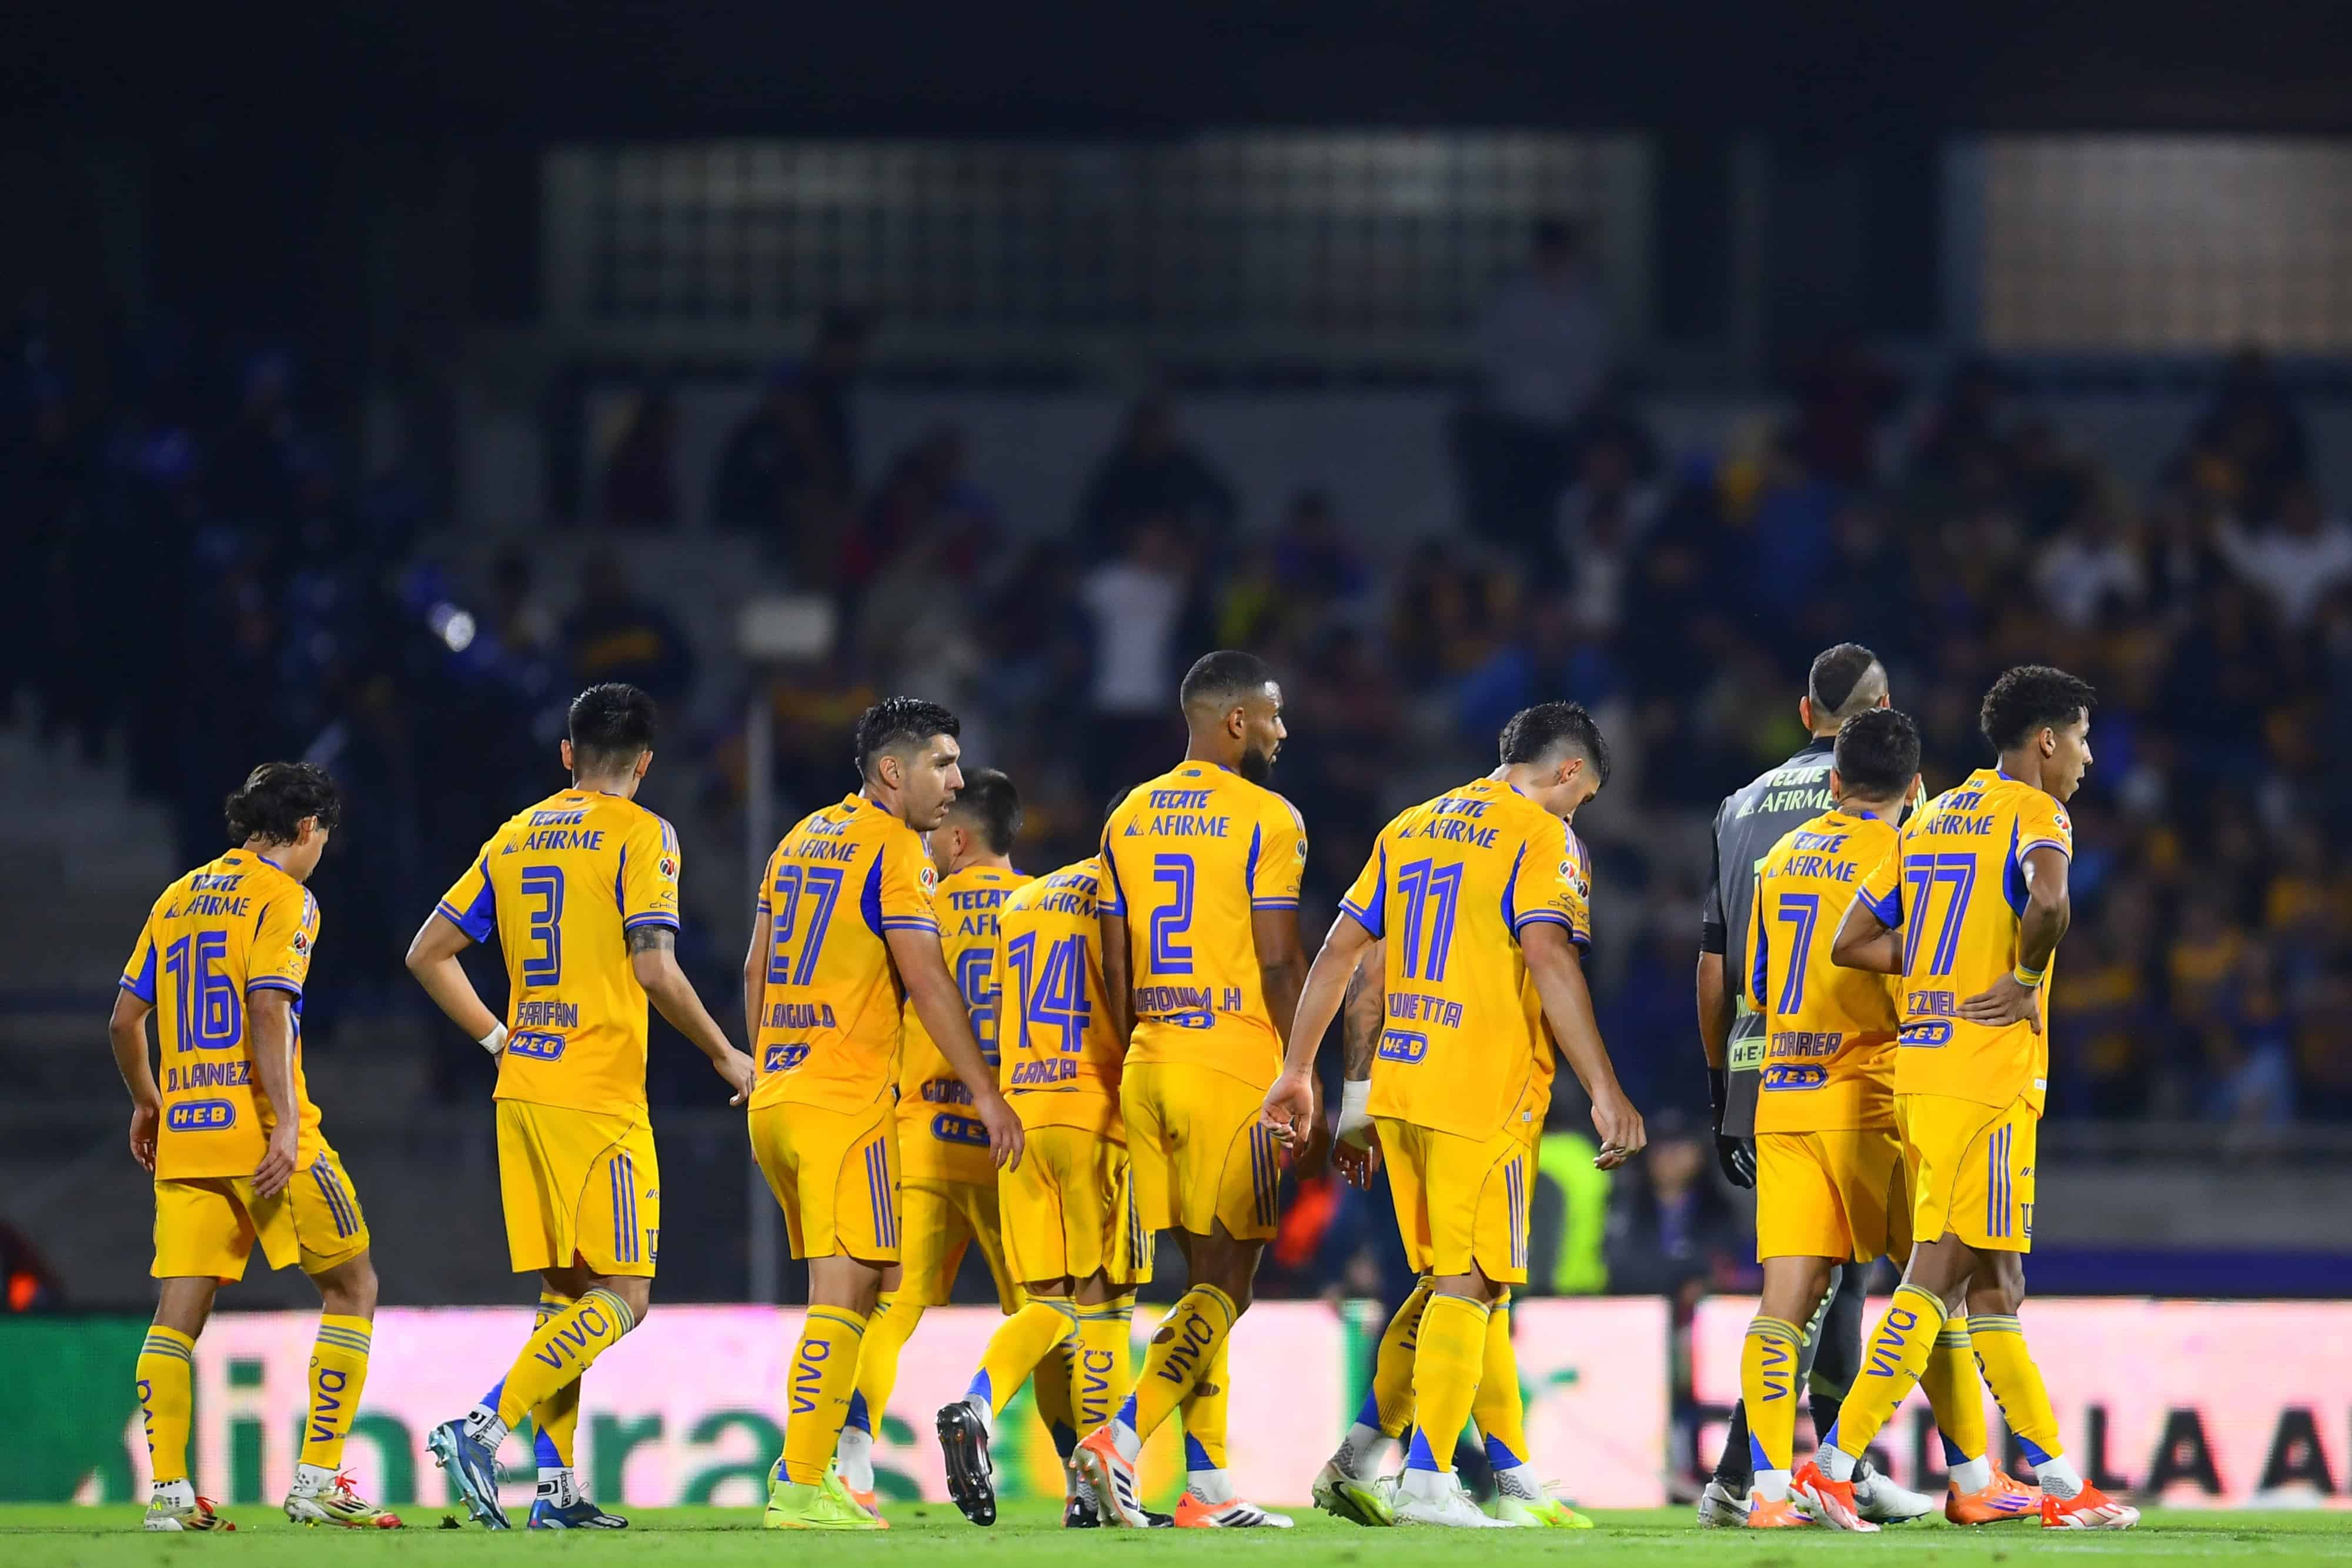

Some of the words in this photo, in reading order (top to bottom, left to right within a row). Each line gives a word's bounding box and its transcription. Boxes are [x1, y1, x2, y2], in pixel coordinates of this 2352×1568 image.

[1148, 790, 1216, 809] TECATE
[1759, 788, 1836, 814] AFIRME
[528, 809, 590, 827] TECATE
[1149, 815, 1231, 837] AFIRME
[1922, 815, 1995, 835] AFIRME
[523, 830, 605, 851] AFIRME
[1423, 818, 1500, 849] AFIRME
[796, 839, 860, 862] AFIRME
[1781, 856, 1859, 882] AFIRME
[183, 895, 251, 917] AFIRME
[1035, 893, 1099, 920] AFIRM
[1150, 853, 1195, 974] 2
[1398, 857, 1464, 982] 11
[1903, 852, 1977, 978] 77
[521, 865, 564, 987] 3
[767, 864, 844, 986] 27
[1777, 893, 1819, 1016] 7
[166, 931, 240, 1054] 16
[1008, 930, 1092, 1052] 14
[514, 1001, 579, 1028] FARFAN
[1769, 1031, 1843, 1057] CORREA
